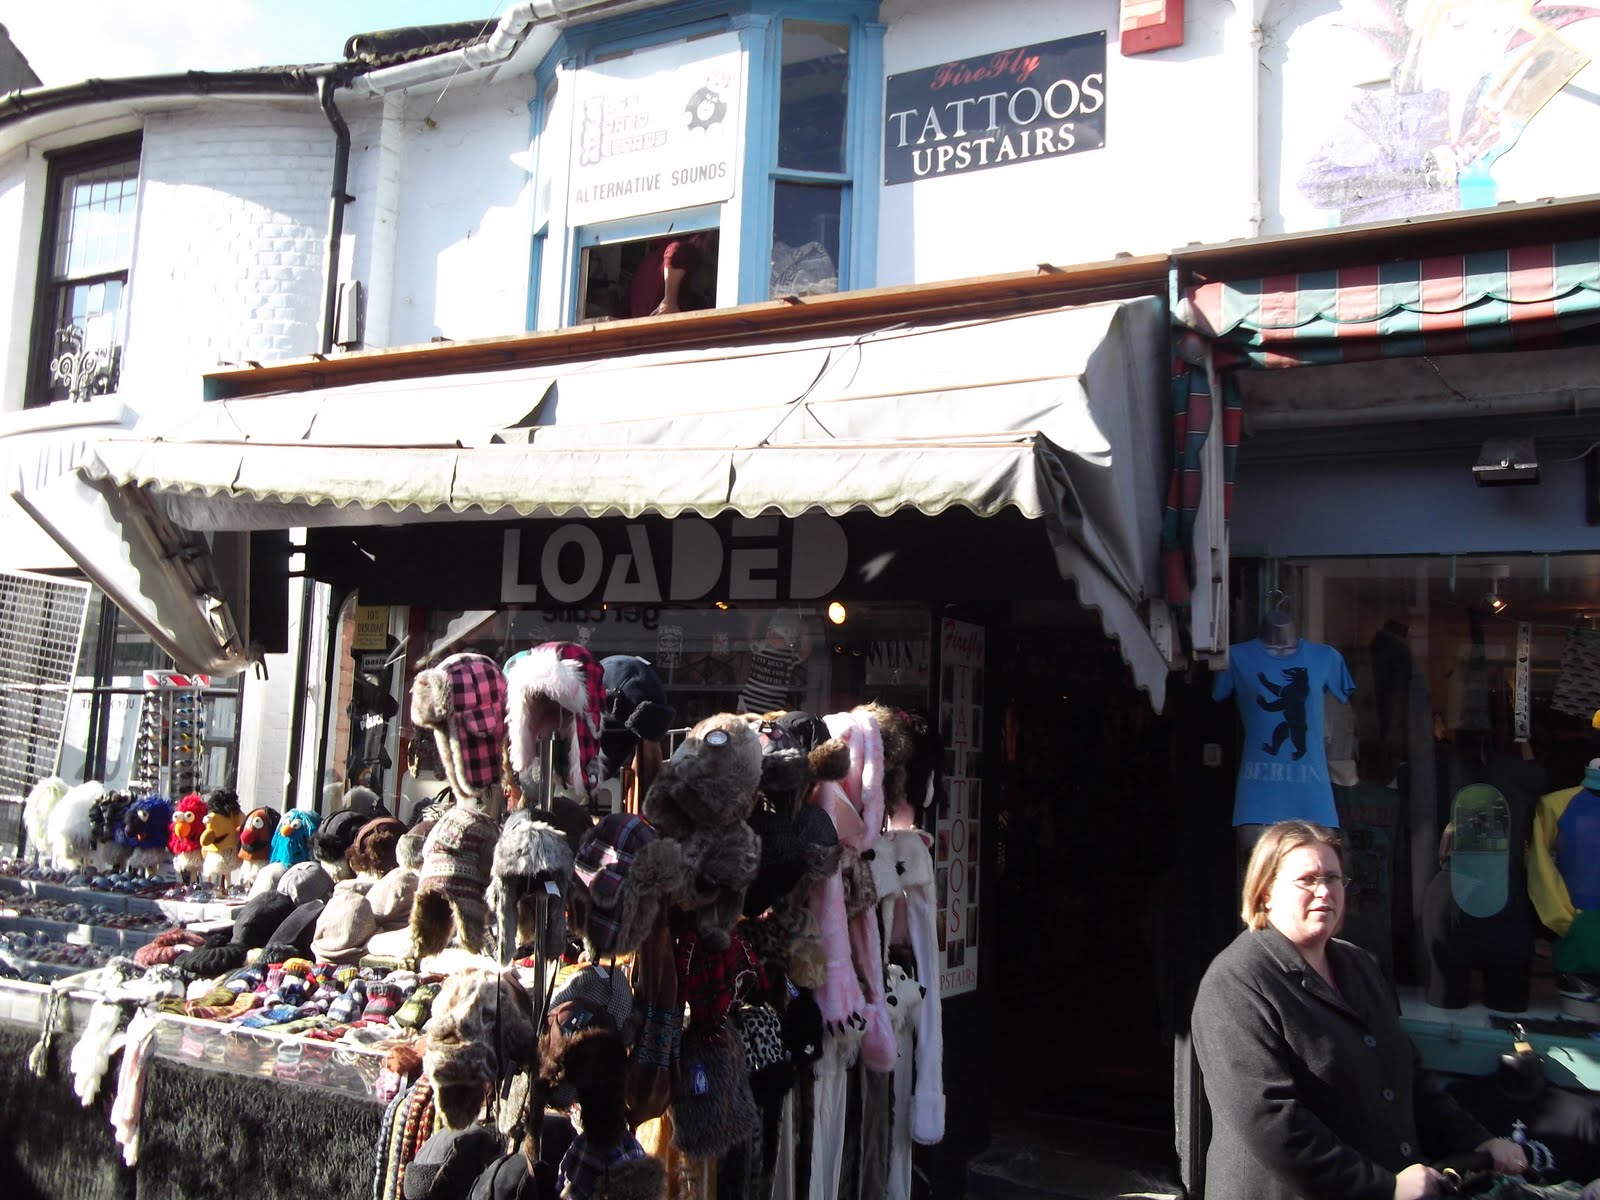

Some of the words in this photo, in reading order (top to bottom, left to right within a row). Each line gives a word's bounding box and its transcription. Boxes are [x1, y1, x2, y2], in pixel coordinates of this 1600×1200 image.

[930, 48, 1040, 90] FireFly
[888, 73, 1104, 147] TATTOOS
[912, 123, 1075, 176] UPSTAIRS
[576, 173, 661, 203] ALTERNATIVE
[671, 162, 726, 186] SOUNDS
[501, 515, 849, 602] LOADED
[357, 623, 384, 633] DISCOUNT
[365, 657, 386, 666] oasis
[118, 699, 135, 709] YOU
[1244, 761, 1321, 783] BERLIN
[950, 665, 970, 934] TATTOOS
[940, 971, 977, 991] PSTAIRS
